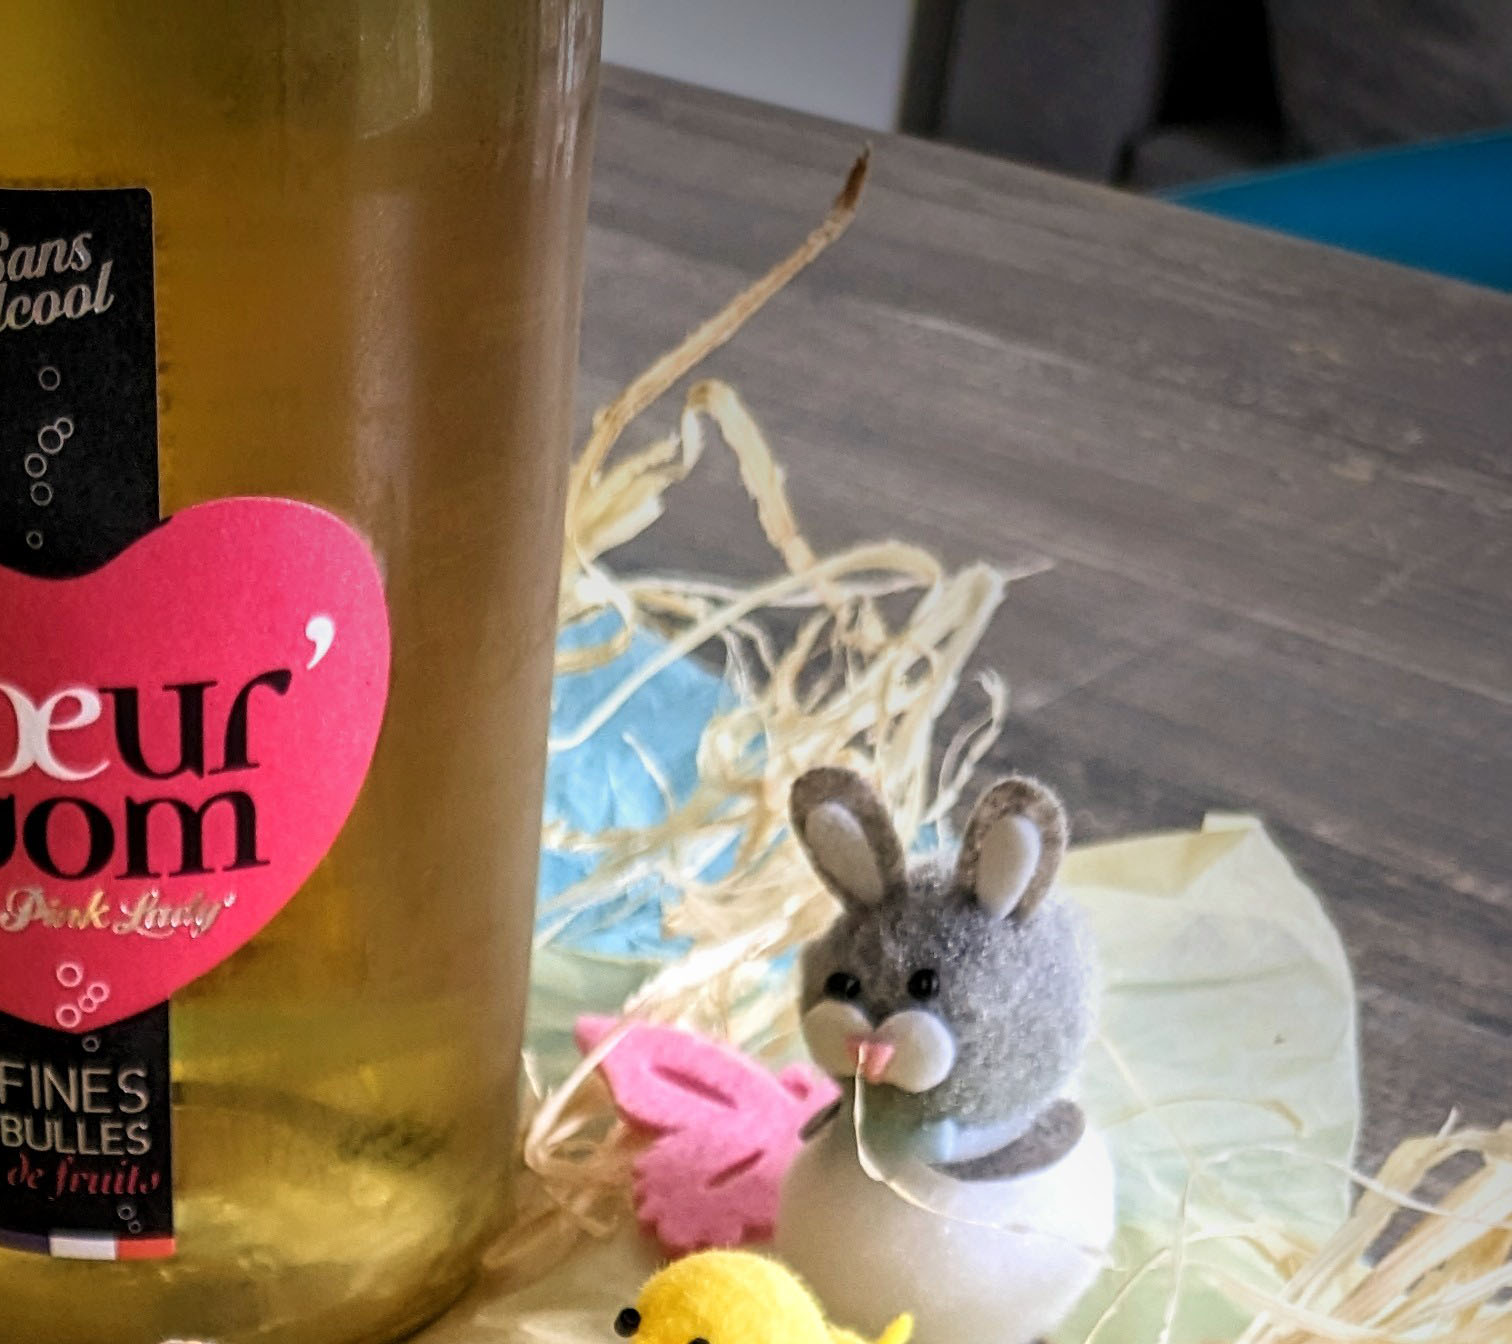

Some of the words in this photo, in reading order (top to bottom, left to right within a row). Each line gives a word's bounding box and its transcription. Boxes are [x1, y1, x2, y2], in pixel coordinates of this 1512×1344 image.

[0, 1112, 152, 1156] BULLES
[7, 1152, 45, 1190] de
[48, 1154, 162, 1201] fruits
